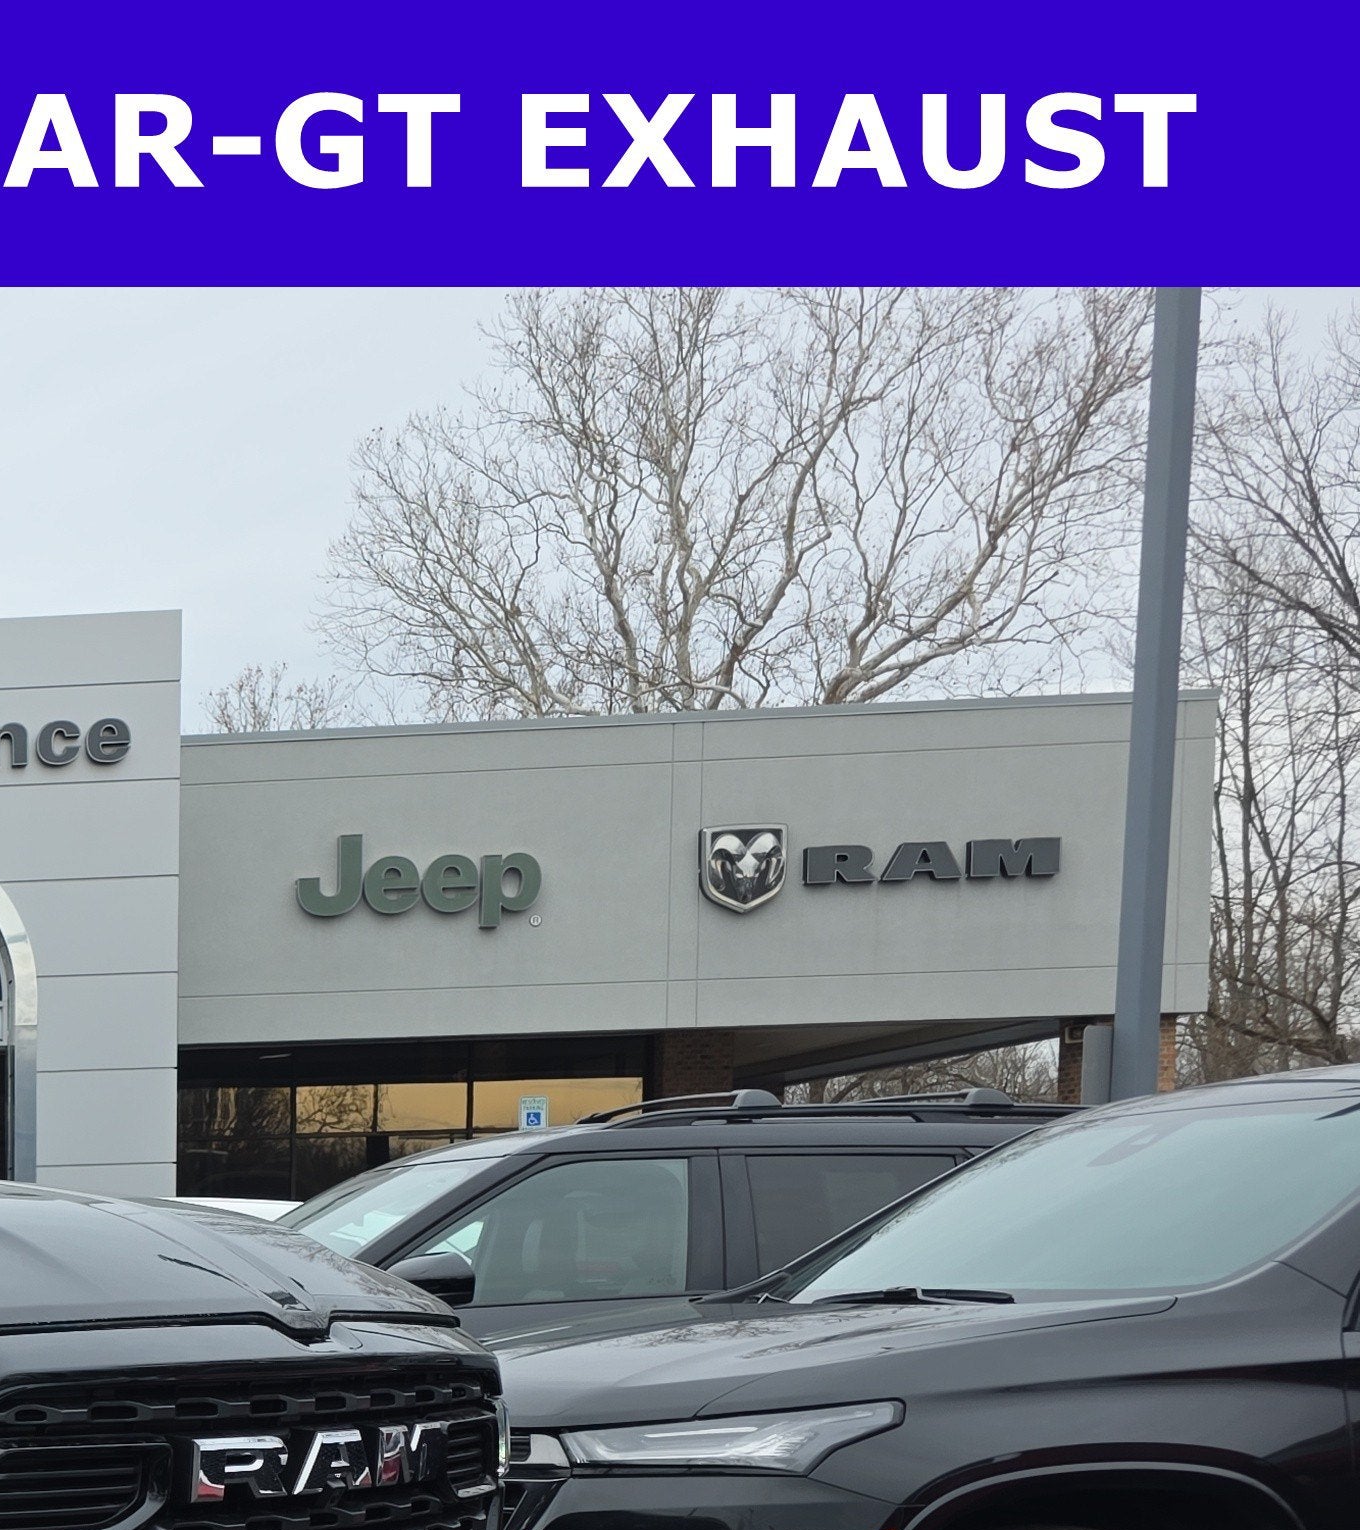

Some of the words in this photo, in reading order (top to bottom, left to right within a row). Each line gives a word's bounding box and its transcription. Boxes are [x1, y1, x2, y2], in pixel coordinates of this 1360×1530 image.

[295, 833, 543, 930] Jeep
[801, 836, 1063, 887] RAM
[188, 1420, 445, 1503] RAM
